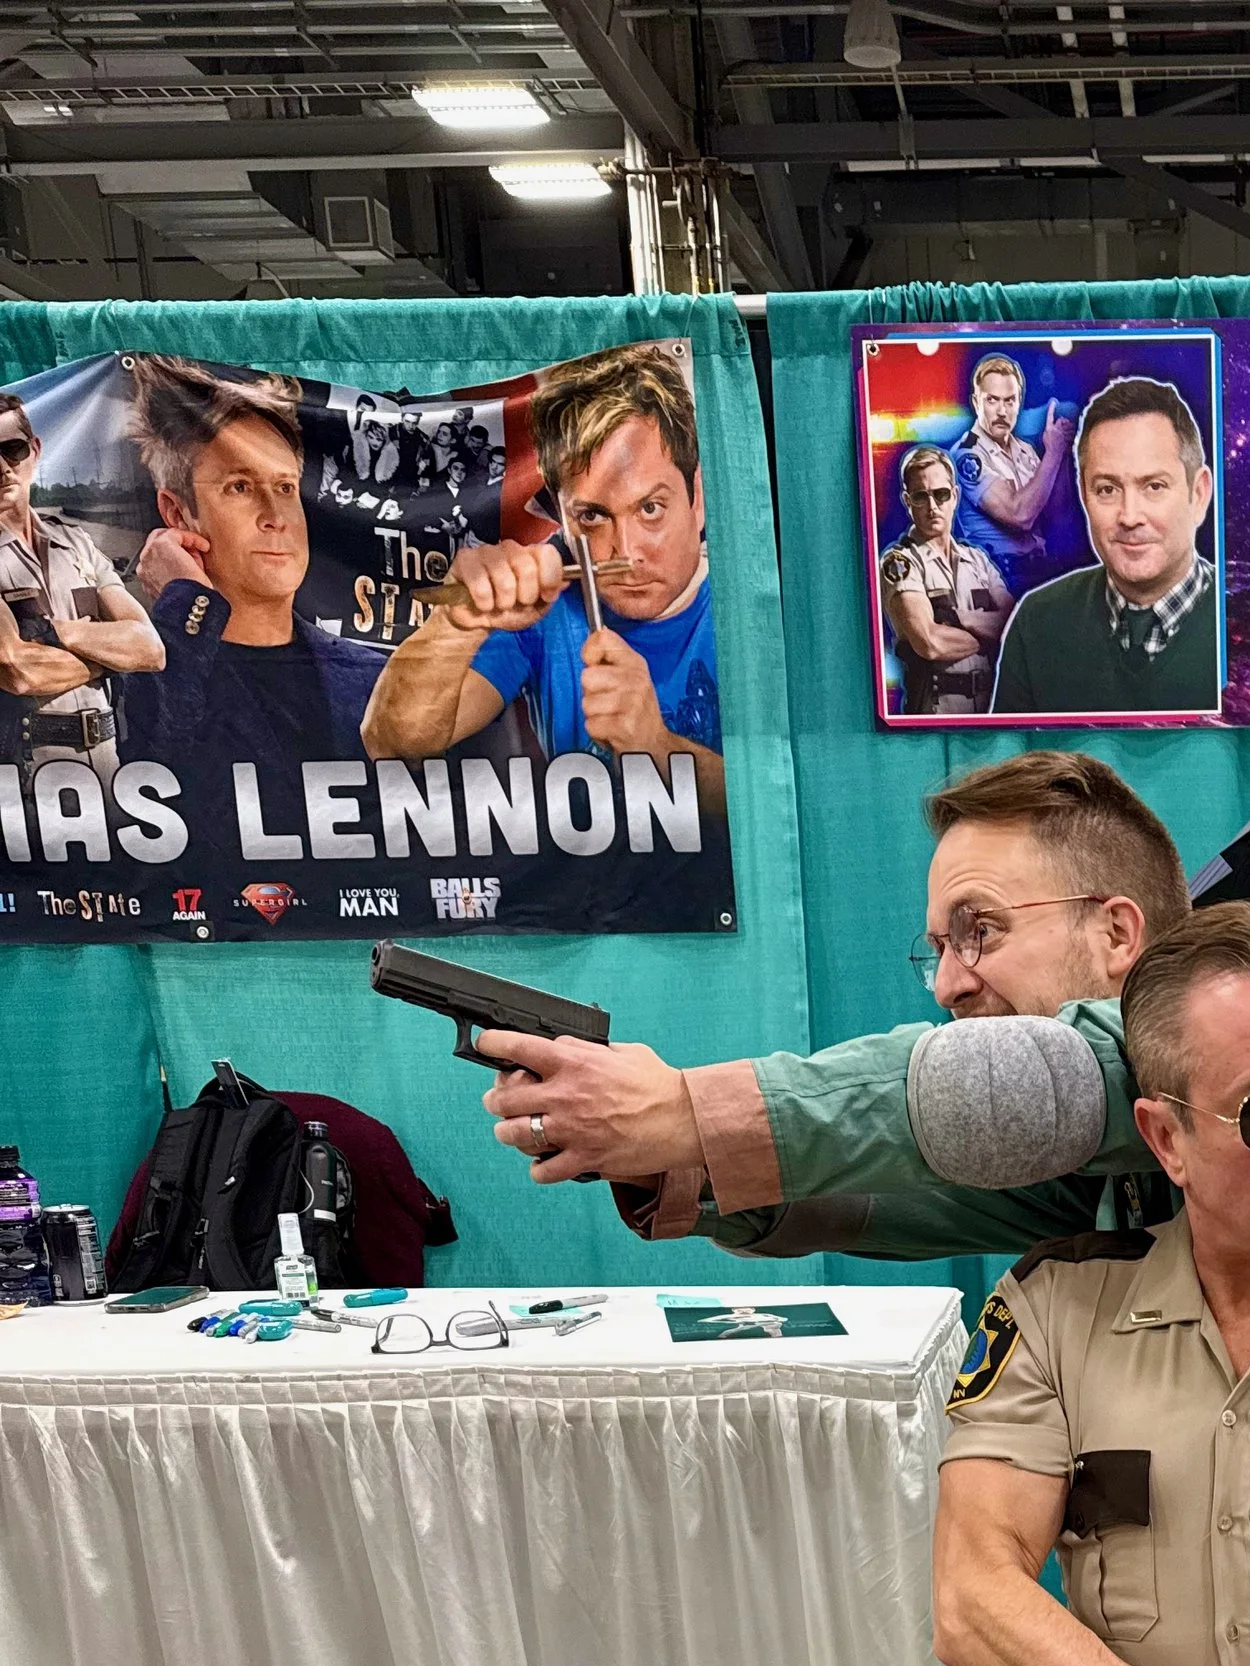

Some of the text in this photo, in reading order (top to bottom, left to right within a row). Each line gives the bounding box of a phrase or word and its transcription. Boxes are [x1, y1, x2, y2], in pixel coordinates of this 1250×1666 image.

[373, 526, 449, 583] The
[232, 752, 702, 861] LENNON
[339, 887, 400, 898] I LOVE YOU,
[430, 877, 501, 898] BALLS
[37, 890, 77, 915] The
[172, 889, 202, 911] 17
[233, 898, 308, 907] SUPERGIRL
[340, 897, 399, 917] MAN
[436, 898, 498, 919] FURY
[172, 910, 206, 921] AGAIN
